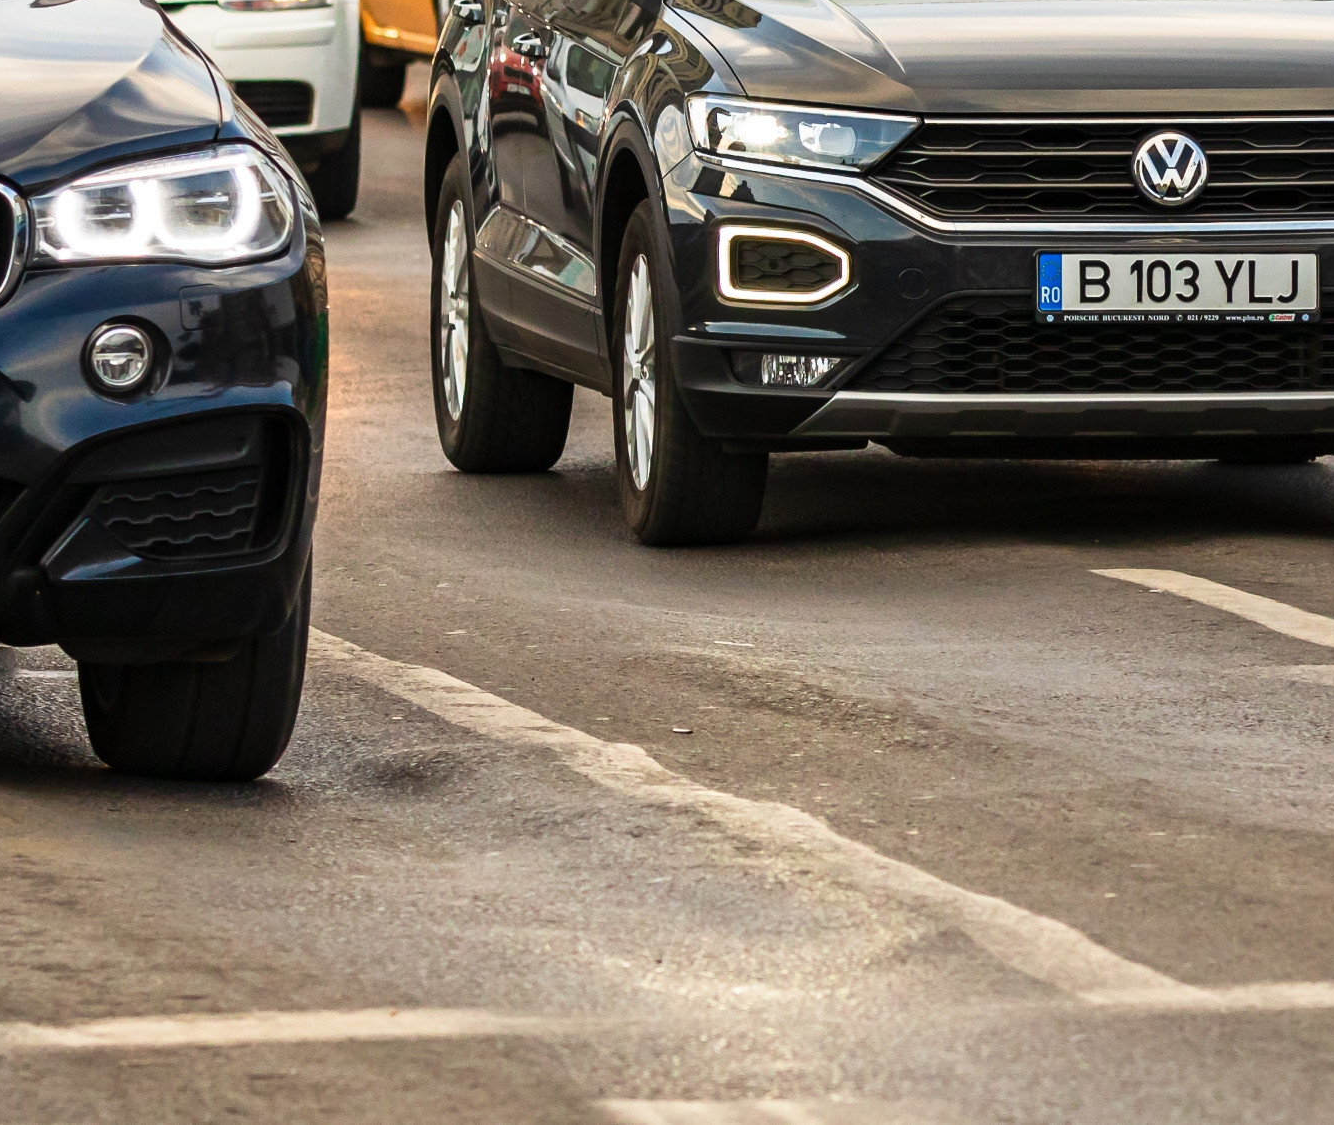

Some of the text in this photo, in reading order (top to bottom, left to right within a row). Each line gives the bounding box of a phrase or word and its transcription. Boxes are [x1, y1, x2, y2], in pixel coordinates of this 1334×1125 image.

[1041, 286, 1061, 303] RO
[1079, 259, 1299, 304] B 103 YLJ
